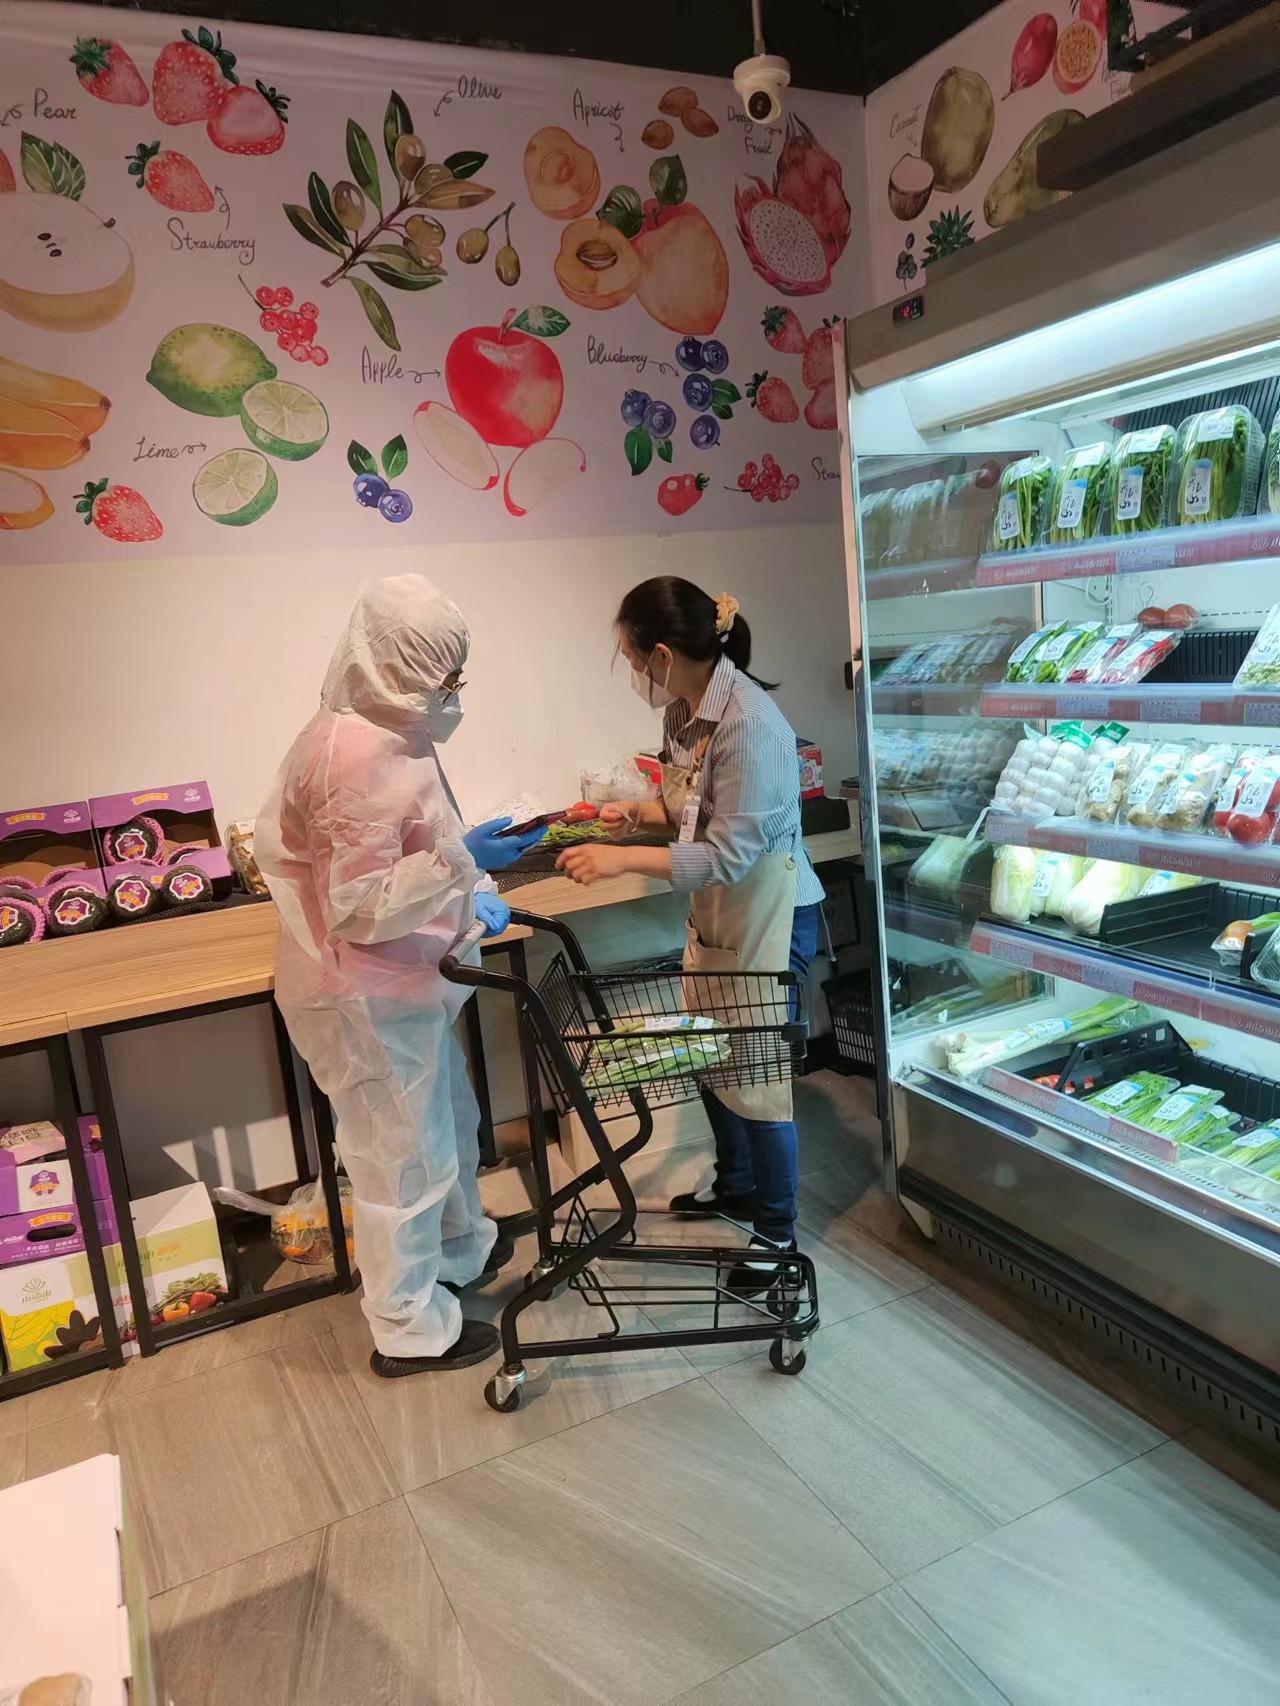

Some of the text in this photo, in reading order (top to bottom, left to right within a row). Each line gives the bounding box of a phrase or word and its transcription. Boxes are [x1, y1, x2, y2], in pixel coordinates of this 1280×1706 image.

[458, 75, 502, 99] Olive
[33, 88, 77, 119] Pear
[573, 88, 624, 127] Apricot
[727, 105, 754, 133] Drag
[744, 136, 773, 154] Fruit
[361, 345, 405, 384] Apple
[132, 436, 180, 462] Lime
